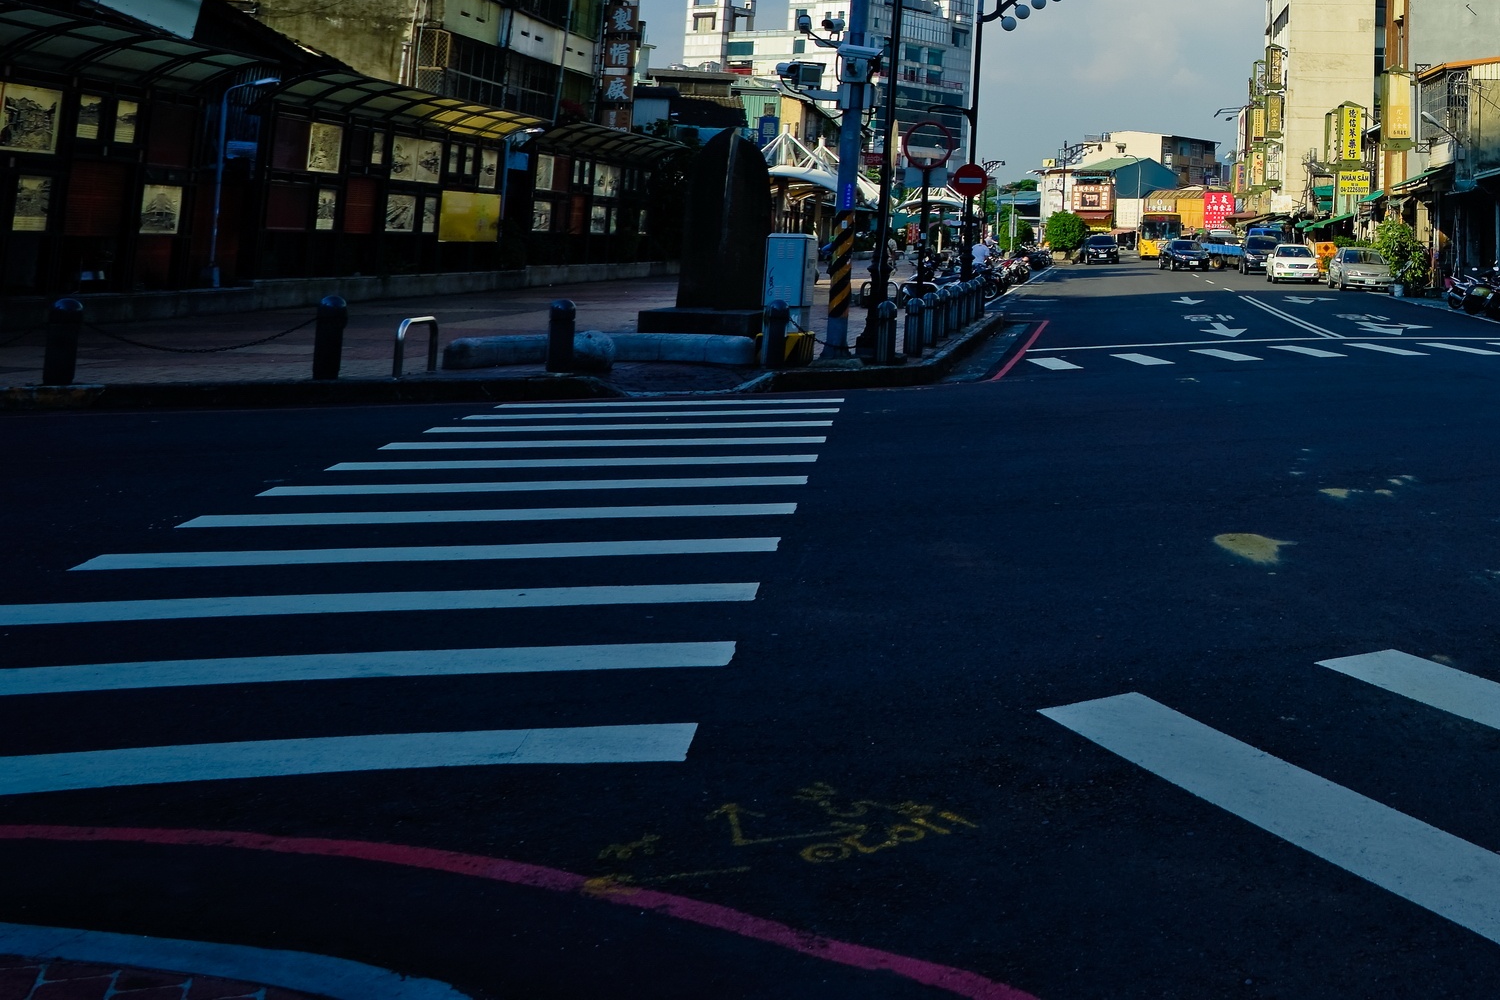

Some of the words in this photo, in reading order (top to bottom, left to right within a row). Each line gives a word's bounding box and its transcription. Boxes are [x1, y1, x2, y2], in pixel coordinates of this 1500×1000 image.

[1210, 194, 1228, 204] 上友
[1207, 204, 1232, 212] 牛肉食品
